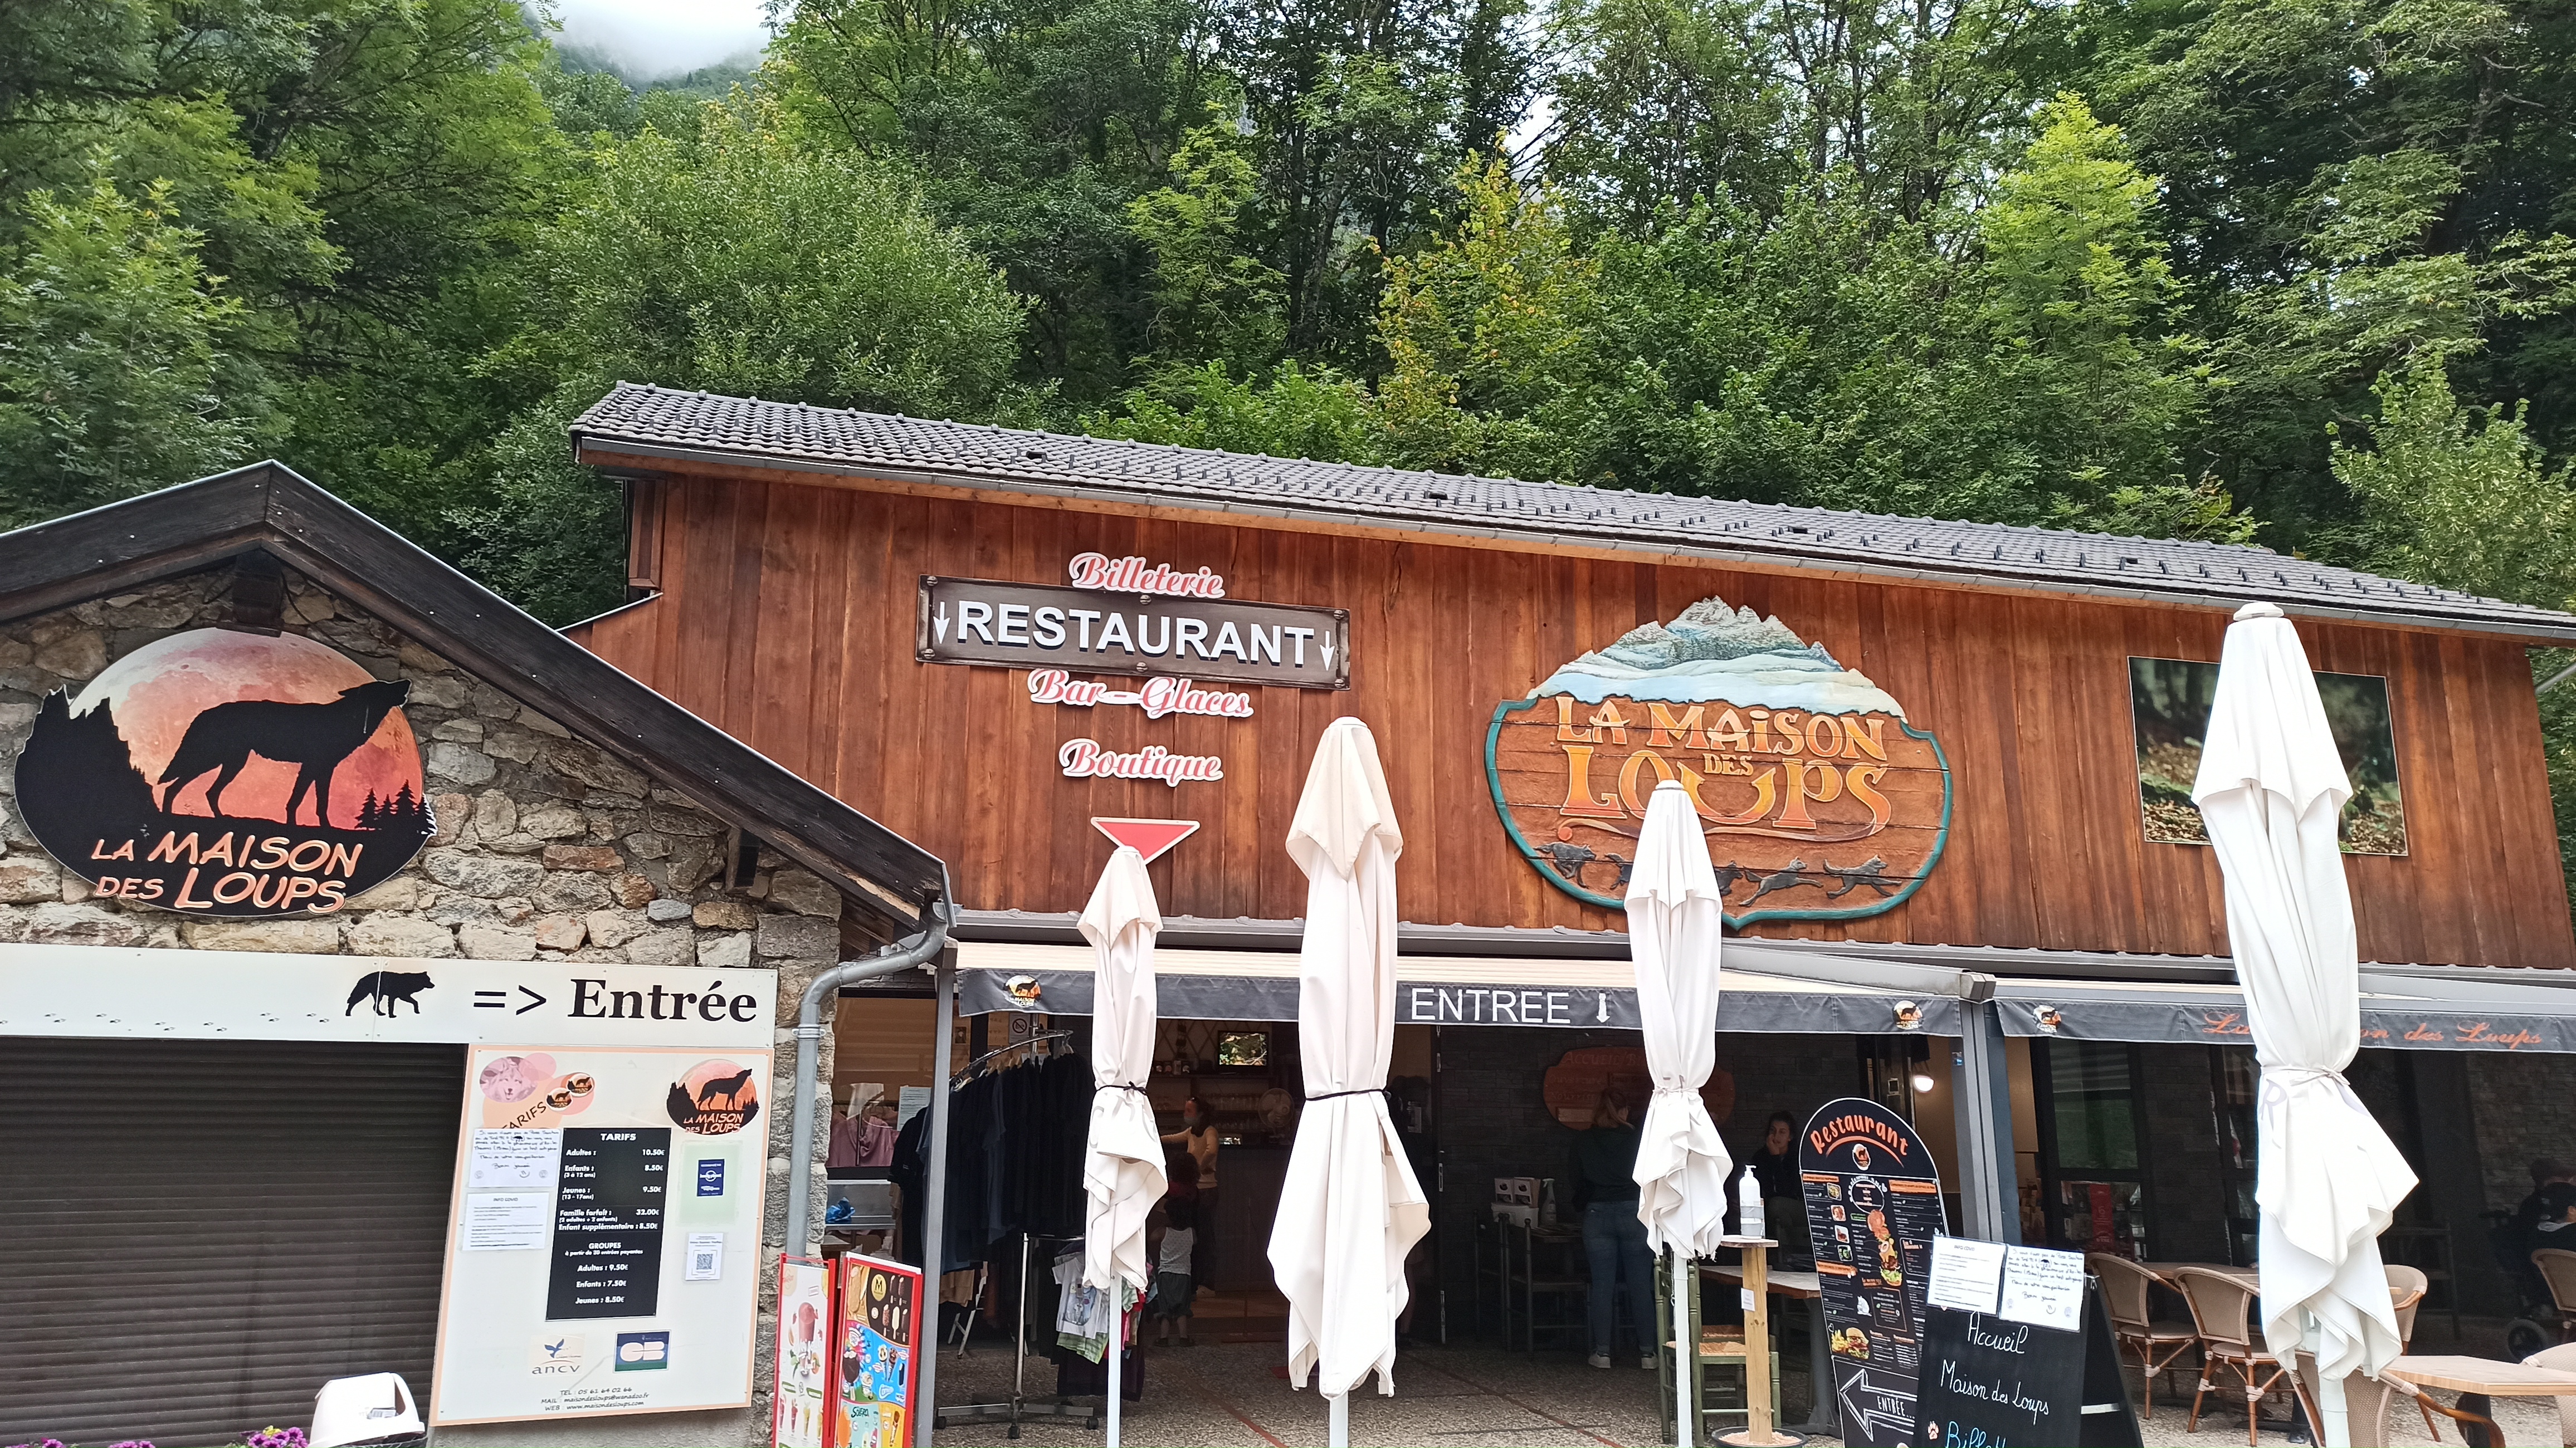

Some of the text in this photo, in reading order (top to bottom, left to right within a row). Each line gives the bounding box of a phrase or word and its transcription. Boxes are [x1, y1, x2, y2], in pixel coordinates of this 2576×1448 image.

[1072, 554, 1224, 597] Billeterie
[957, 600, 1314, 666] RESTAURANT
[1556, 696, 1629, 745] LA
[1062, 740, 1223, 785] Boutique
[1704, 753, 1754, 776] DES
[1560, 745, 1892, 830] LOUPS
[91, 831, 364, 878] LA MAISON
[95, 867, 347, 914] DES LOUPS
[568, 979, 757, 1023] Entrée
[1411, 987, 1571, 1024] ENTREE
[2403, 1023, 2445, 1041] des
[2455, 1021, 2543, 1049] Loups
[502, 1102, 546, 1128] ARIFS
[695, 1113, 744, 1123] MAISON
[702, 1123, 741, 1134] LOUPS
[1811, 1115, 1908, 1156] Restaurant
[1968, 1310, 2029, 1354] Accueil
[531, 1365, 581, 1374] ancv
[564, 1393, 649, 1402] maisondesloups@wanadoo.fr
[567, 1401, 644, 1410] www.maisondesloups.com
[1940, 1359, 2049, 1426] Maison des Loups
